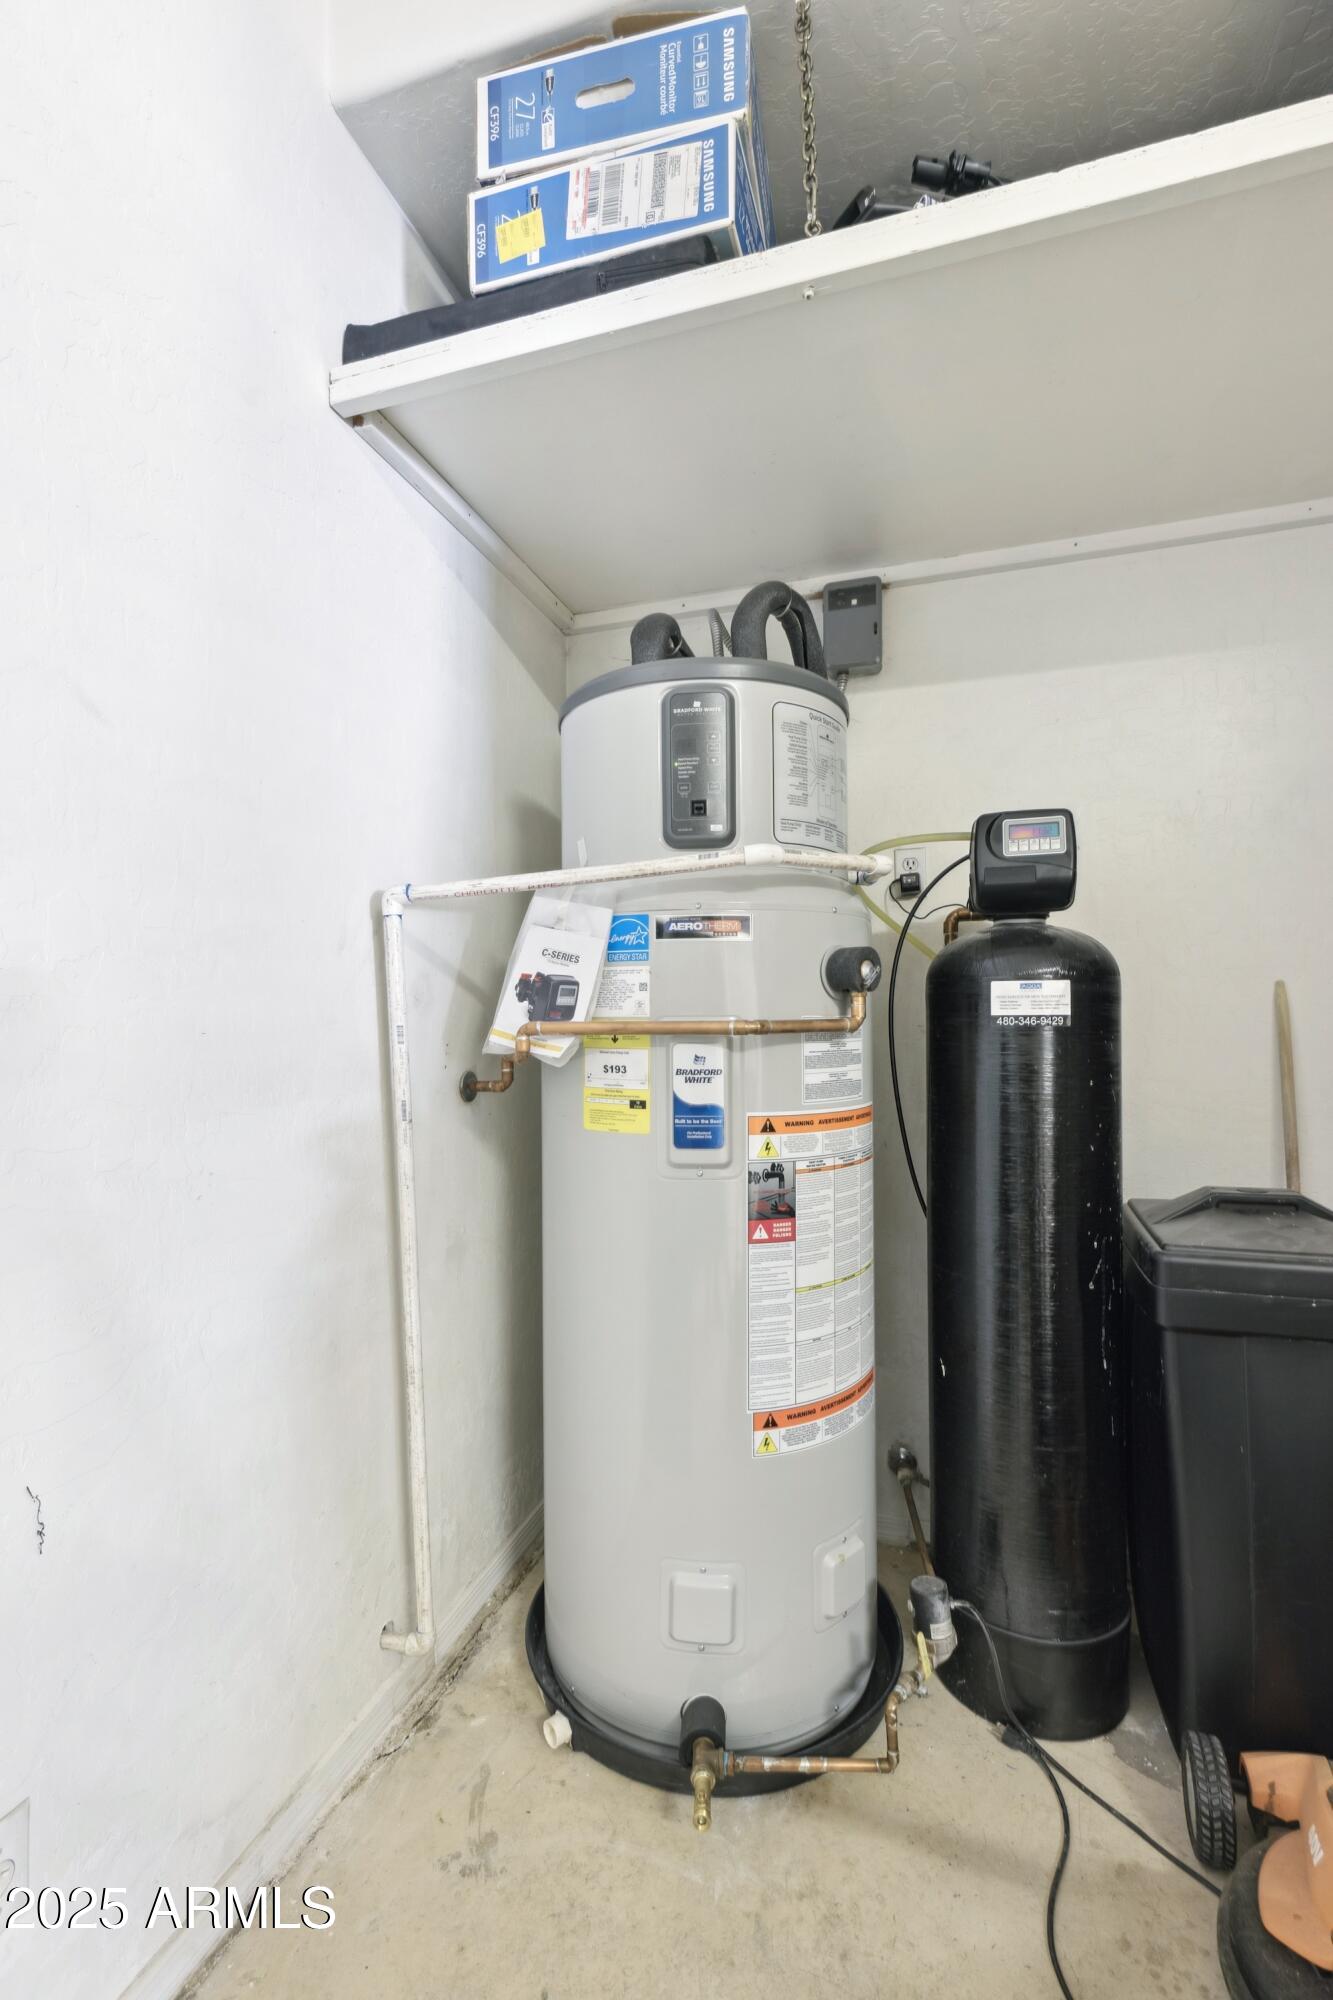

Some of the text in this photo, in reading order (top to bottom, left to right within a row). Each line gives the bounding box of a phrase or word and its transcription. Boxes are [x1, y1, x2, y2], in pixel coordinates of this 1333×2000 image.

[723, 27, 735, 102] SAMSUNG
[659, 44, 669, 115] Moniteur courbé
[515, 92, 536, 119] 27
[489, 105, 500, 142] CF396
[703, 138, 715, 212] SAMSUNG
[476, 223, 487, 258] CF396
[668, 921, 738, 931] AEROTHERM
[541, 948, 581, 964] C-SERIES
[608, 952, 647, 961] ENERGY STAR
[996, 1016, 1064, 1026] 480-346-9429
[603, 1064, 627, 1074] $193
[675, 1068, 722, 1076] BRADFORD
[684, 1076, 713, 1084] WHITE
[784, 1119, 815, 1127] WARNING
[818, 1115, 855, 1125] AVERTISSEMENT
[786, 1408, 817, 1421] WARNING
